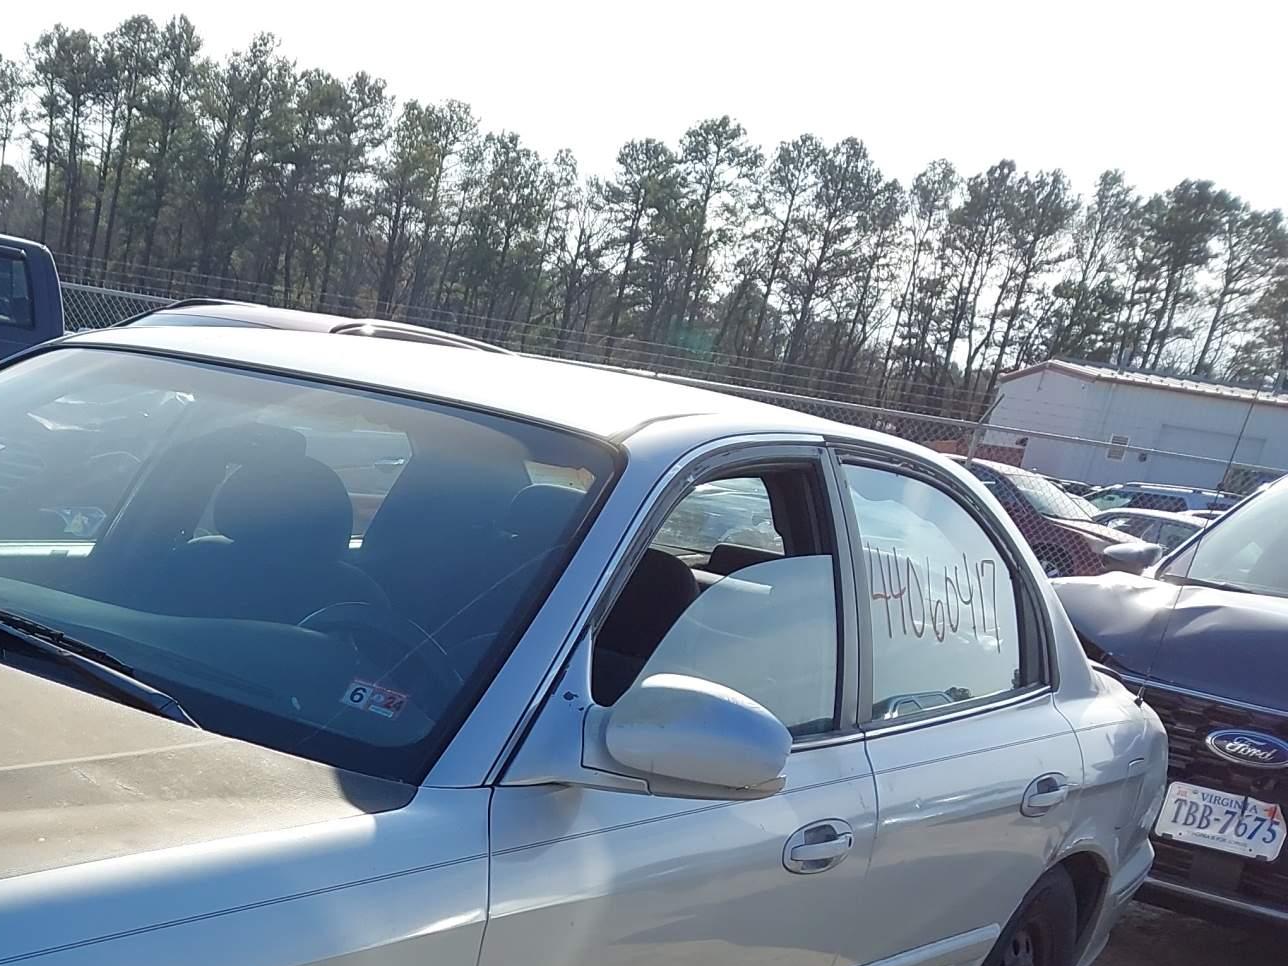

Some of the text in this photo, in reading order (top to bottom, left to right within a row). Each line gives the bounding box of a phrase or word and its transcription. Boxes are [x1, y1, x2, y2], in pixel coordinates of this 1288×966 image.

[867, 541, 1000, 653] 44060417
[349, 687, 367, 704] 6
[1225, 737, 1276, 761] Ford
[1200, 792, 1258, 814] VIRGINA
[1171, 798, 1280, 844] TBB-7675
